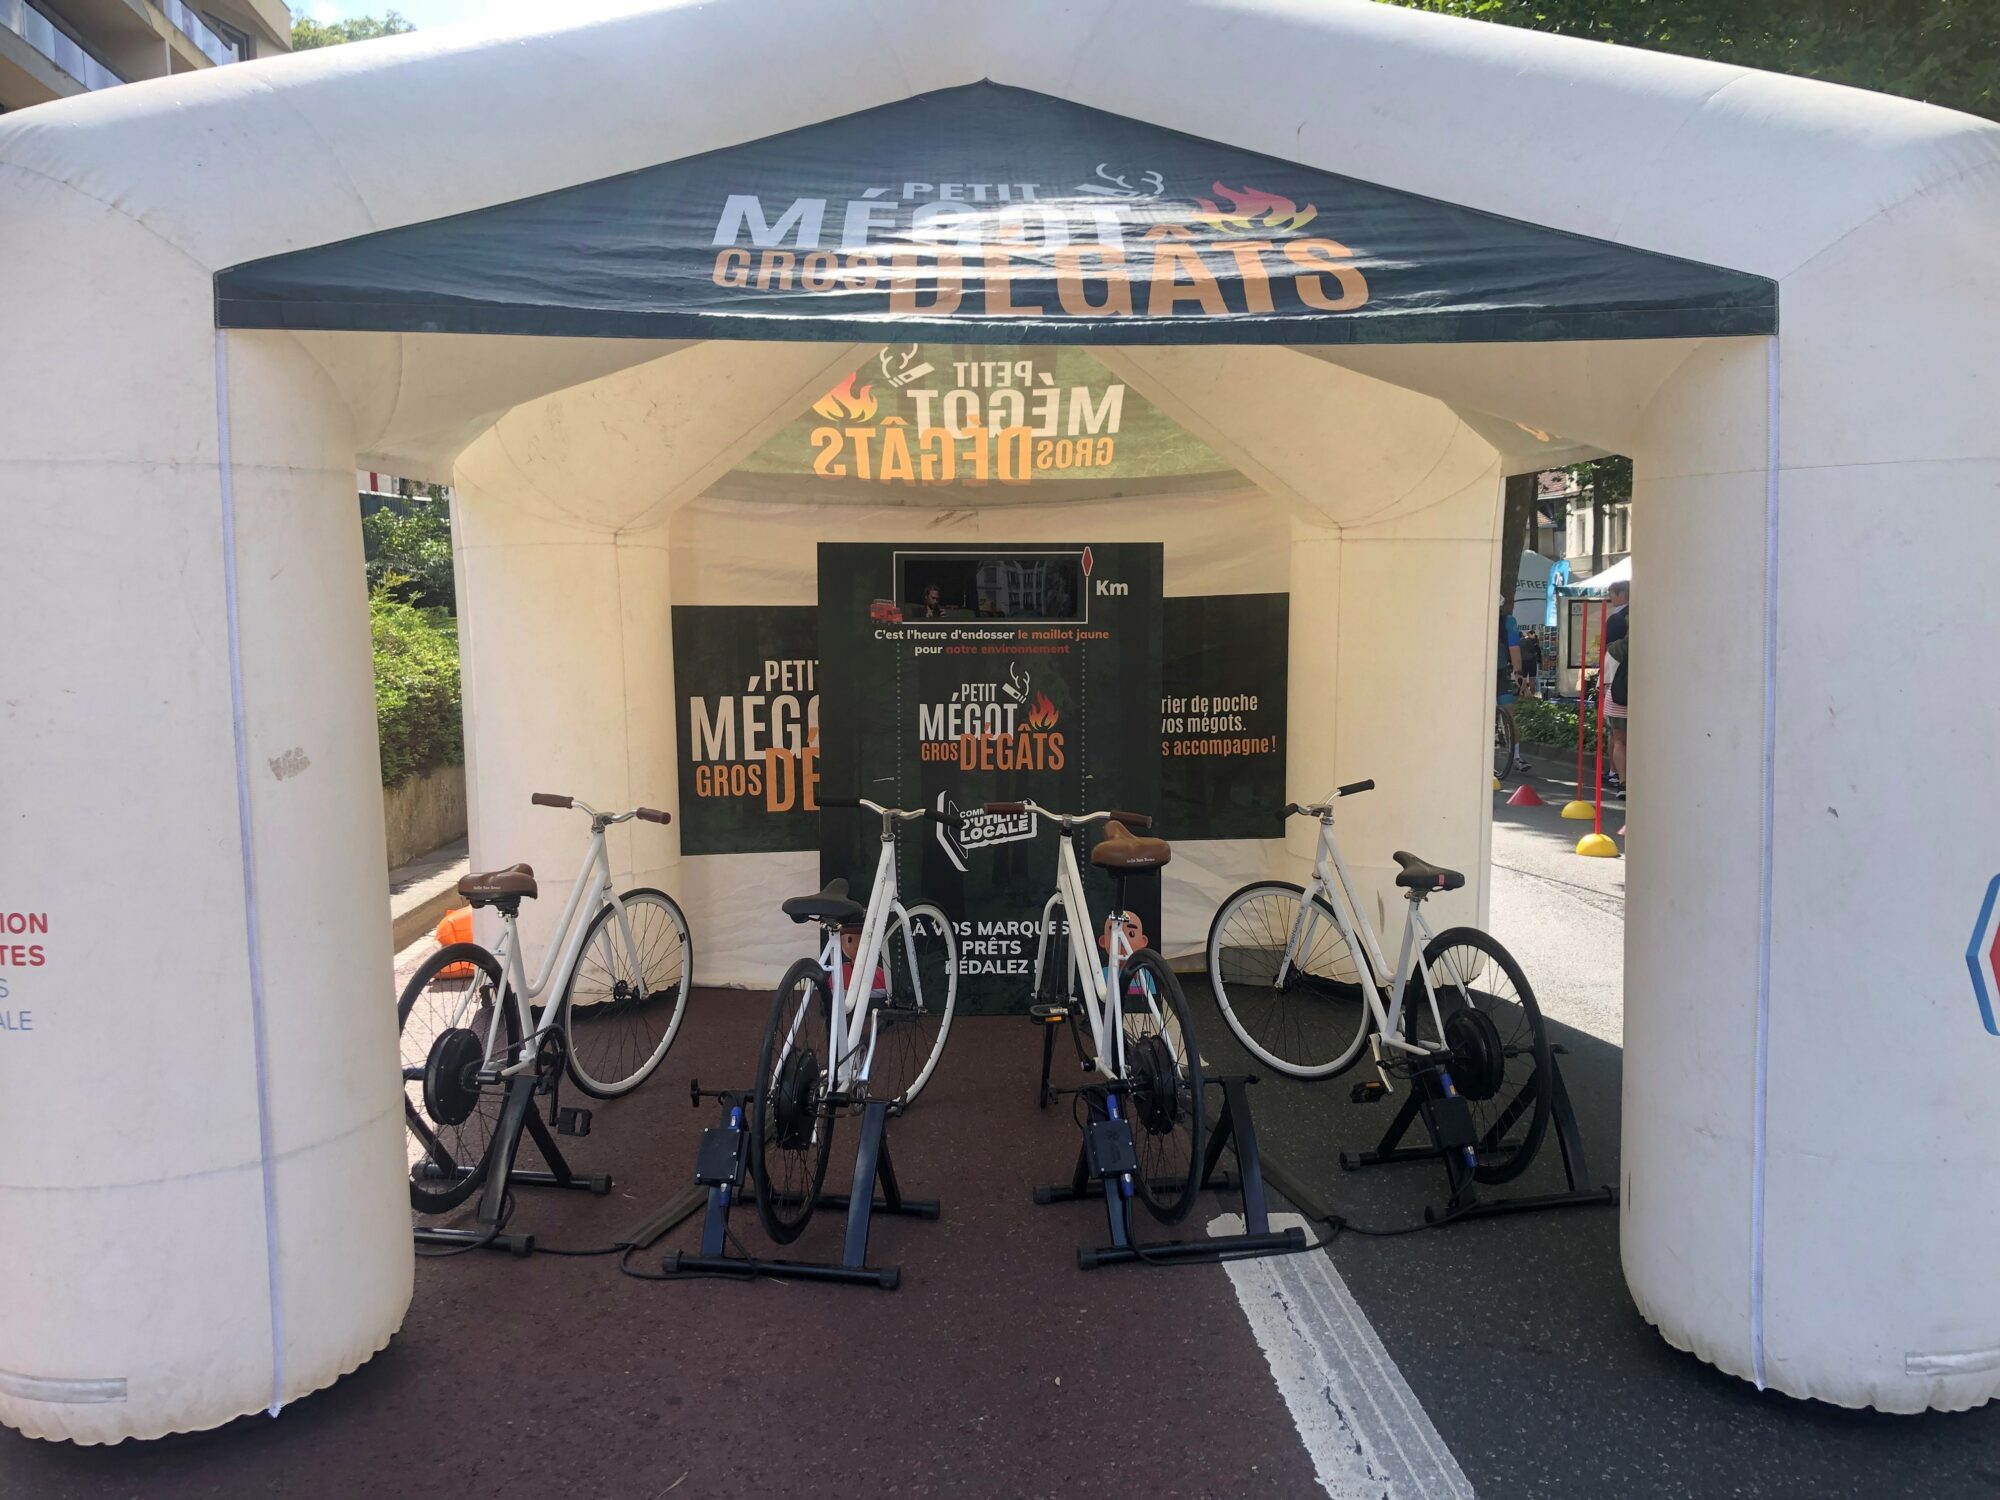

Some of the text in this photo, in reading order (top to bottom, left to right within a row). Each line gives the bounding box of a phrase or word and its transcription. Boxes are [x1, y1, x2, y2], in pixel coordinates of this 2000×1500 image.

[902, 182, 1041, 201] PETIT
[712, 187, 1133, 252] MÉGOT
[711, 224, 1369, 316] GROS DÉGÂTS
[1096, 579, 1129, 596] Km
[874, 629, 1110, 641] C'est l'heure d'endosser le maillot jaune
[914, 644, 1070, 656] pour notre environnement
[764, 660, 819, 692] PETI
[961, 683, 997, 702] PETIT
[1191, 695, 1209, 713] de
[1213, 694, 1258, 714] poche
[919, 692, 1018, 741] MÉGOT
[1187, 713, 1247, 734] mégots.
[921, 722, 1065, 771] GROS DÉGÂTS
[1173, 737, 1269, 757] accompagne
[695, 764, 762, 797] GROS
[961, 819, 1029, 842] LOCALE
[978, 921, 1070, 938] MARQUES
[962, 937, 1022, 954] PRÊTS
